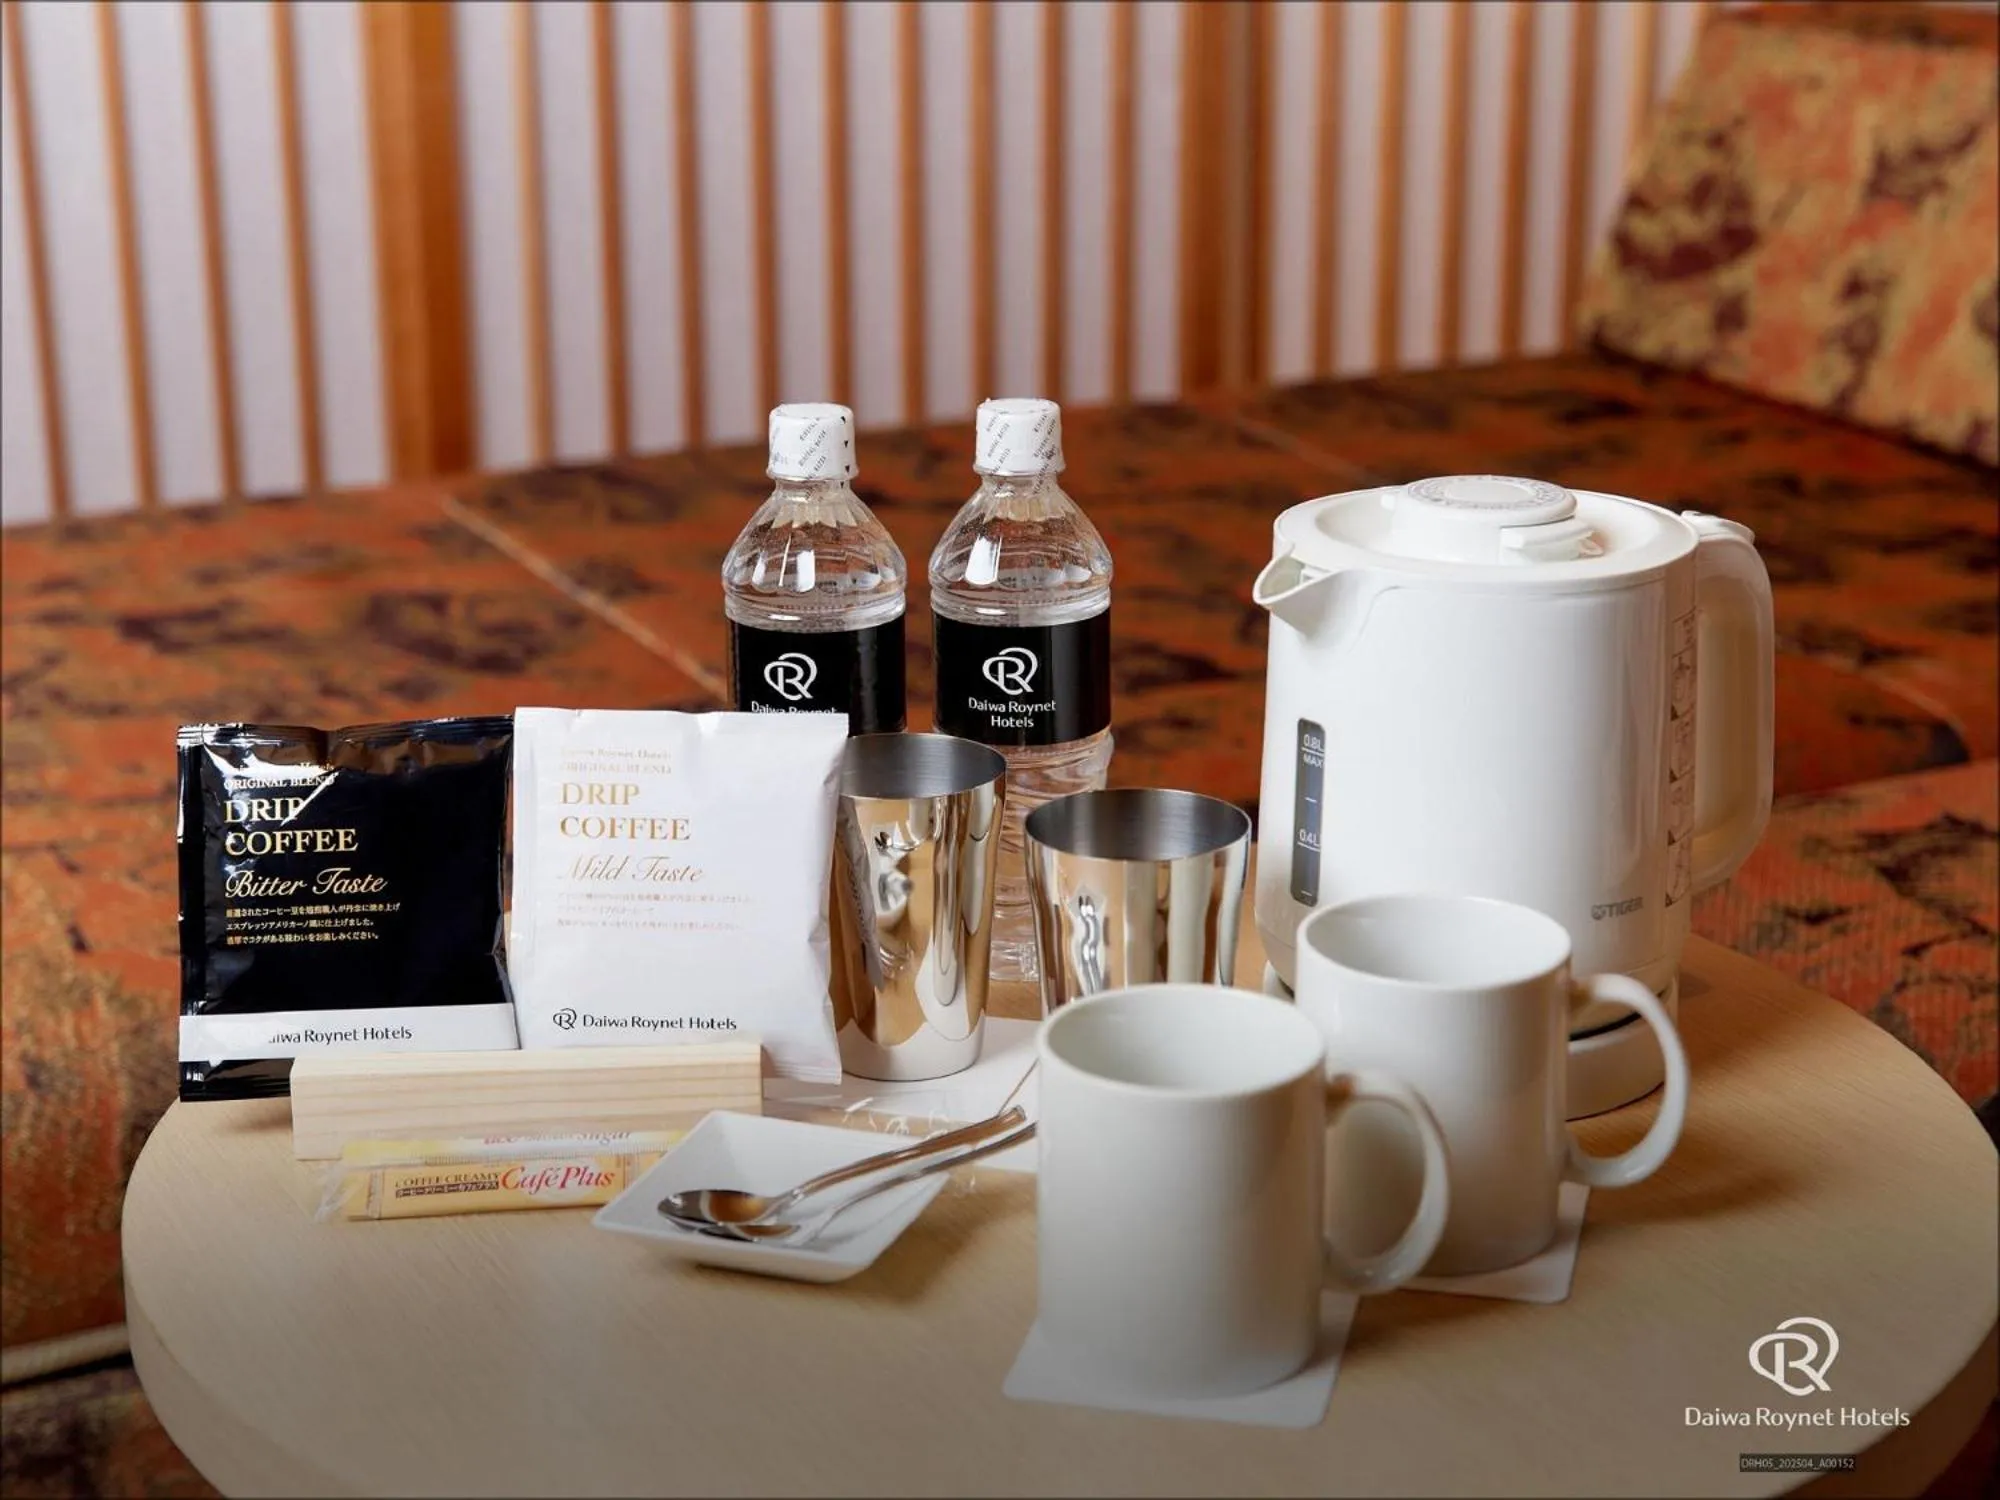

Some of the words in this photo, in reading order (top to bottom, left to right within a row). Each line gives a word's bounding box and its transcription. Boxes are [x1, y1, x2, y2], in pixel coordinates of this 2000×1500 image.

[968, 696, 1006, 713] Daiwa
[1008, 700, 1057, 716] Roynet
[991, 715, 1034, 728] Hotels
[1303, 752, 1325, 768] MAX
[223, 778, 287, 790] ORIGINAL
[561, 782, 640, 806] DRIP
[223, 797, 304, 823] DRIP
[560, 815, 691, 842] COFFEE
[224, 828, 359, 857] COFFEE
[557, 854, 628, 883] Mild
[632, 855, 704, 883] Taste
[225, 870, 307, 899] Bitter
[312, 866, 389, 895] Taste
[583, 1014, 628, 1028] Daiwa
[631, 1016, 684, 1032] Roynet
[689, 1017, 737, 1031] Hotels
[268, 1031, 301, 1044] iwa
[304, 1028, 359, 1045] Roynet
[363, 1026, 412, 1041] Hotels
